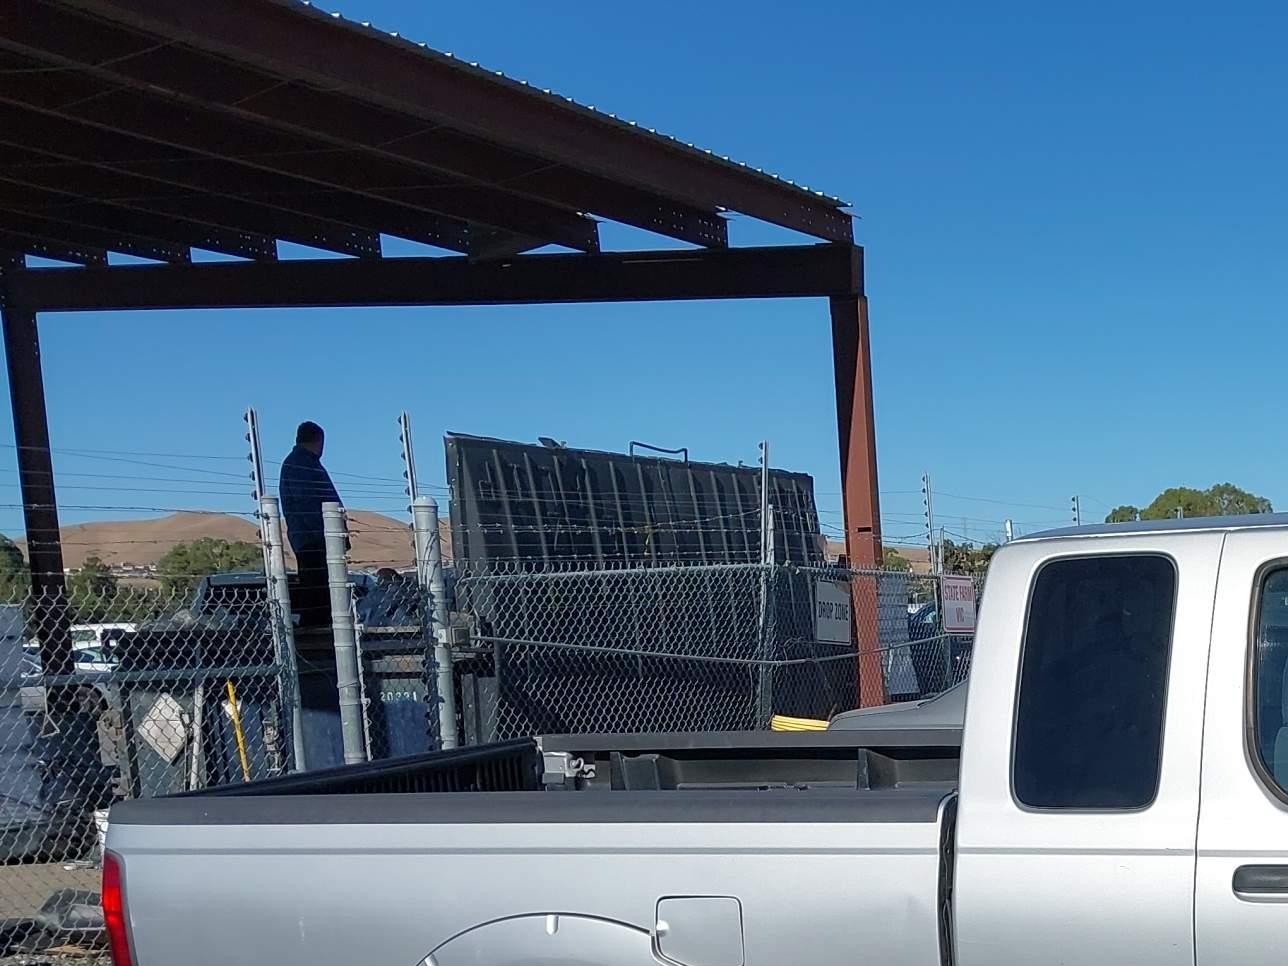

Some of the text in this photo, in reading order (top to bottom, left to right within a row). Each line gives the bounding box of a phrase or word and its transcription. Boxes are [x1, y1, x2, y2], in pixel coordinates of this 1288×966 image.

[944, 584, 959, 601] STATE
[818, 601, 849, 621] DROP ZONE
